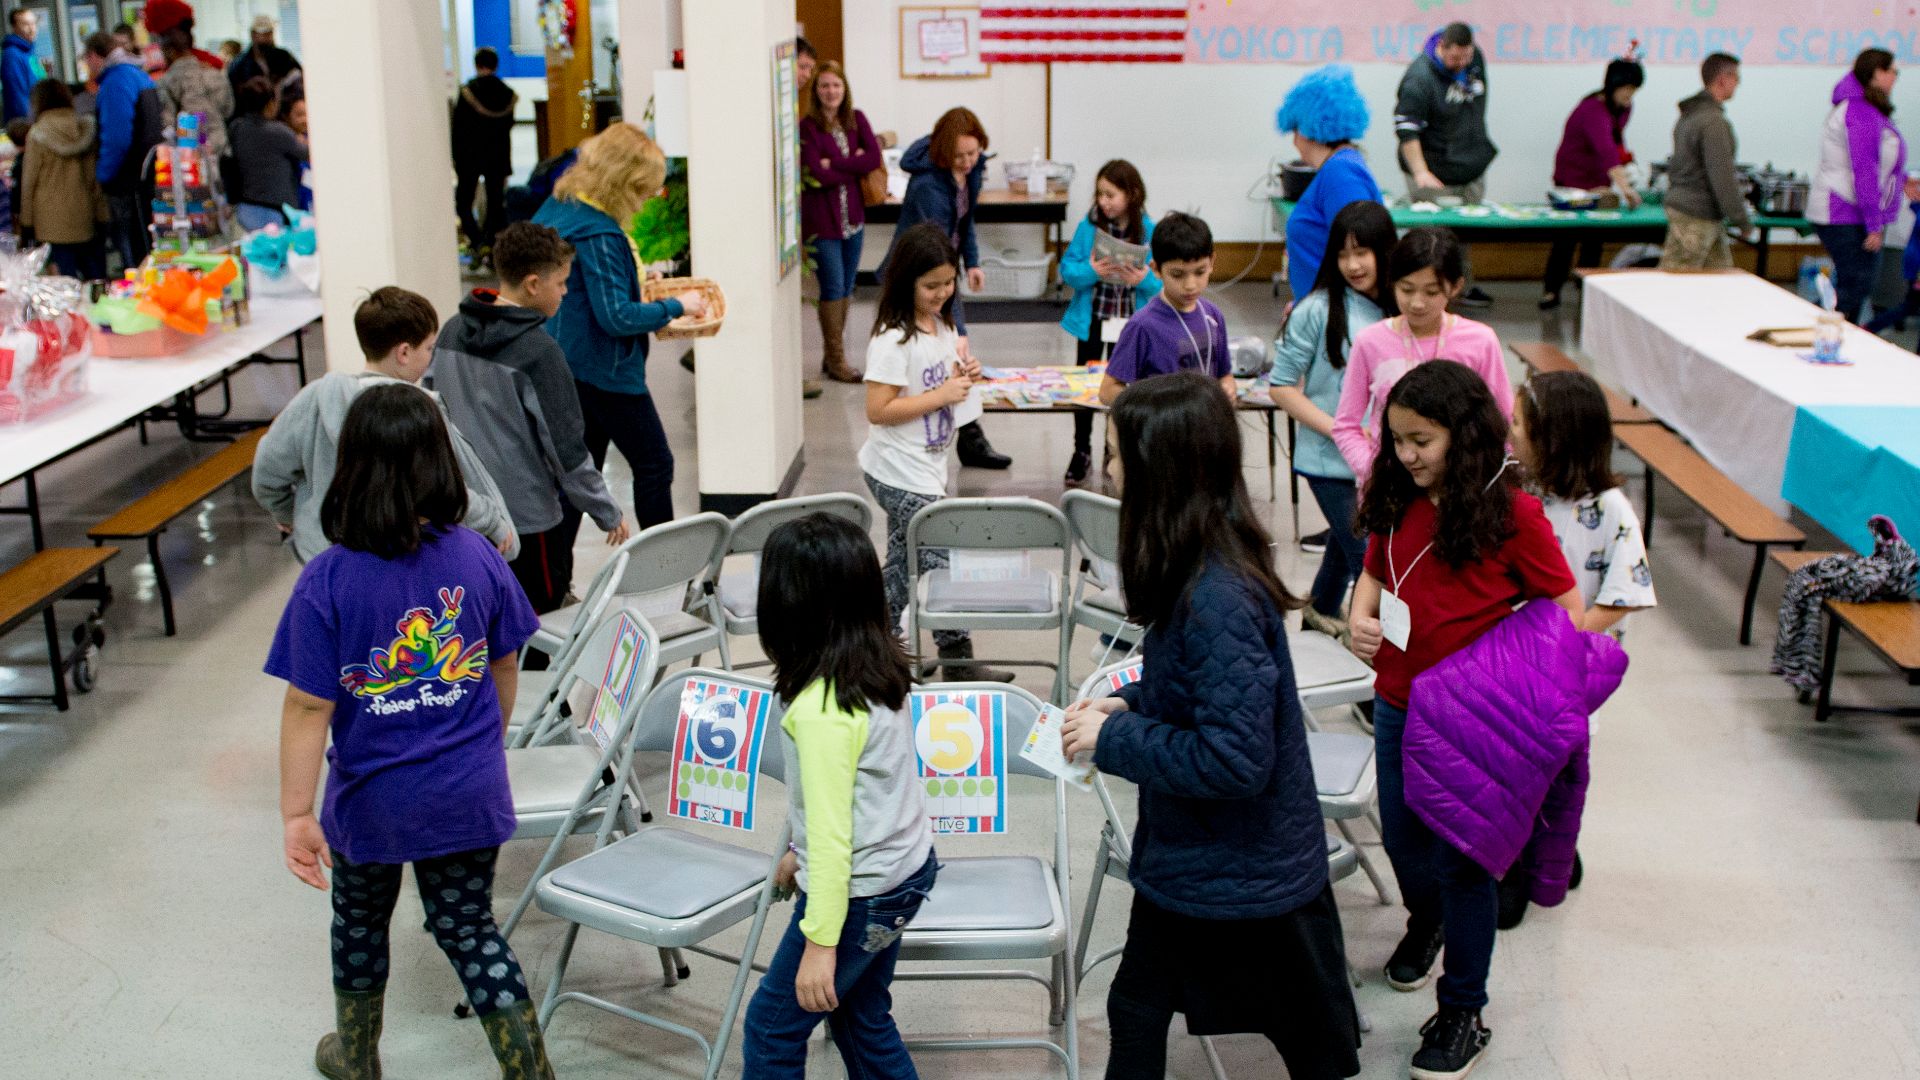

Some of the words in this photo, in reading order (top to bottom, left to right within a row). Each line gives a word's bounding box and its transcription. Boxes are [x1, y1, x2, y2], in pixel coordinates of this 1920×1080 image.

[1191, 26, 1345, 61] YOKOTA
[1495, 24, 1754, 61] ELEMENTARY
[697, 701, 737, 760] 6
[928, 710, 975, 770] 5
[938, 817, 965, 830] five
